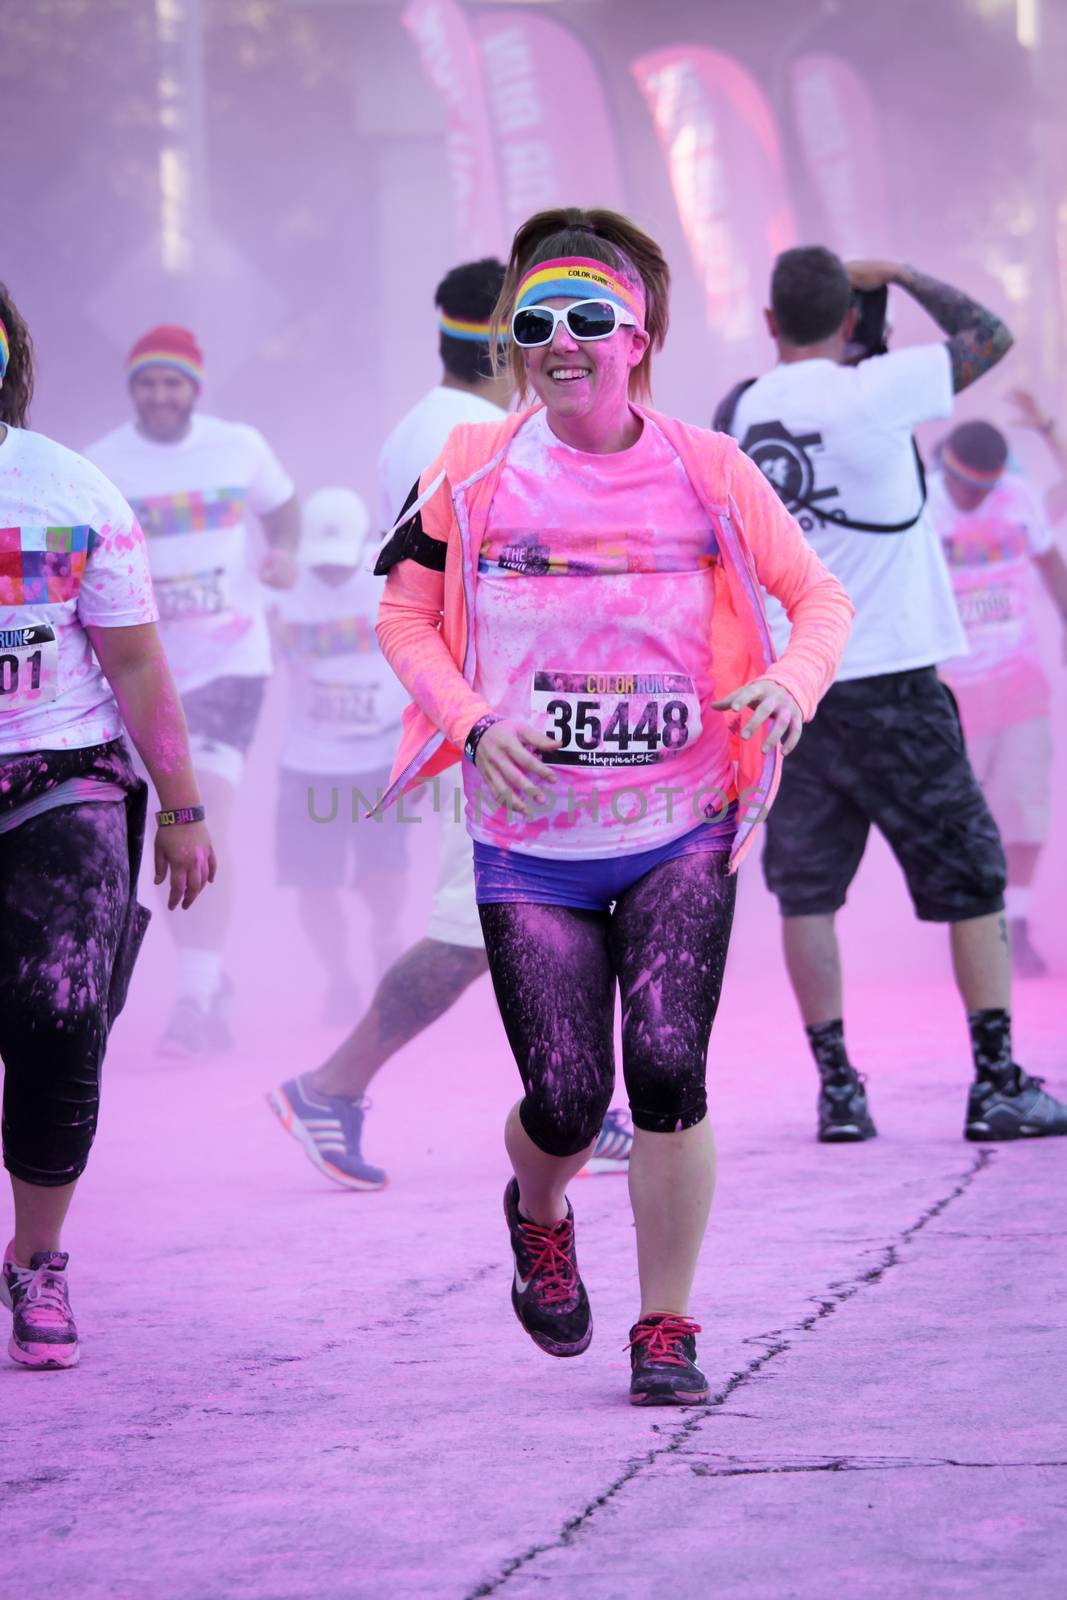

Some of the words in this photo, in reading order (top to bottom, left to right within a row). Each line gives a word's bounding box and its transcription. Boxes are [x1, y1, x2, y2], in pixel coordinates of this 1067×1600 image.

[568, 270, 591, 279] COLOR
[503, 547, 527, 562] THE
[586, 674, 635, 694] COLOR
[637, 675, 664, 694] RUN
[545, 699, 689, 751] 35448
